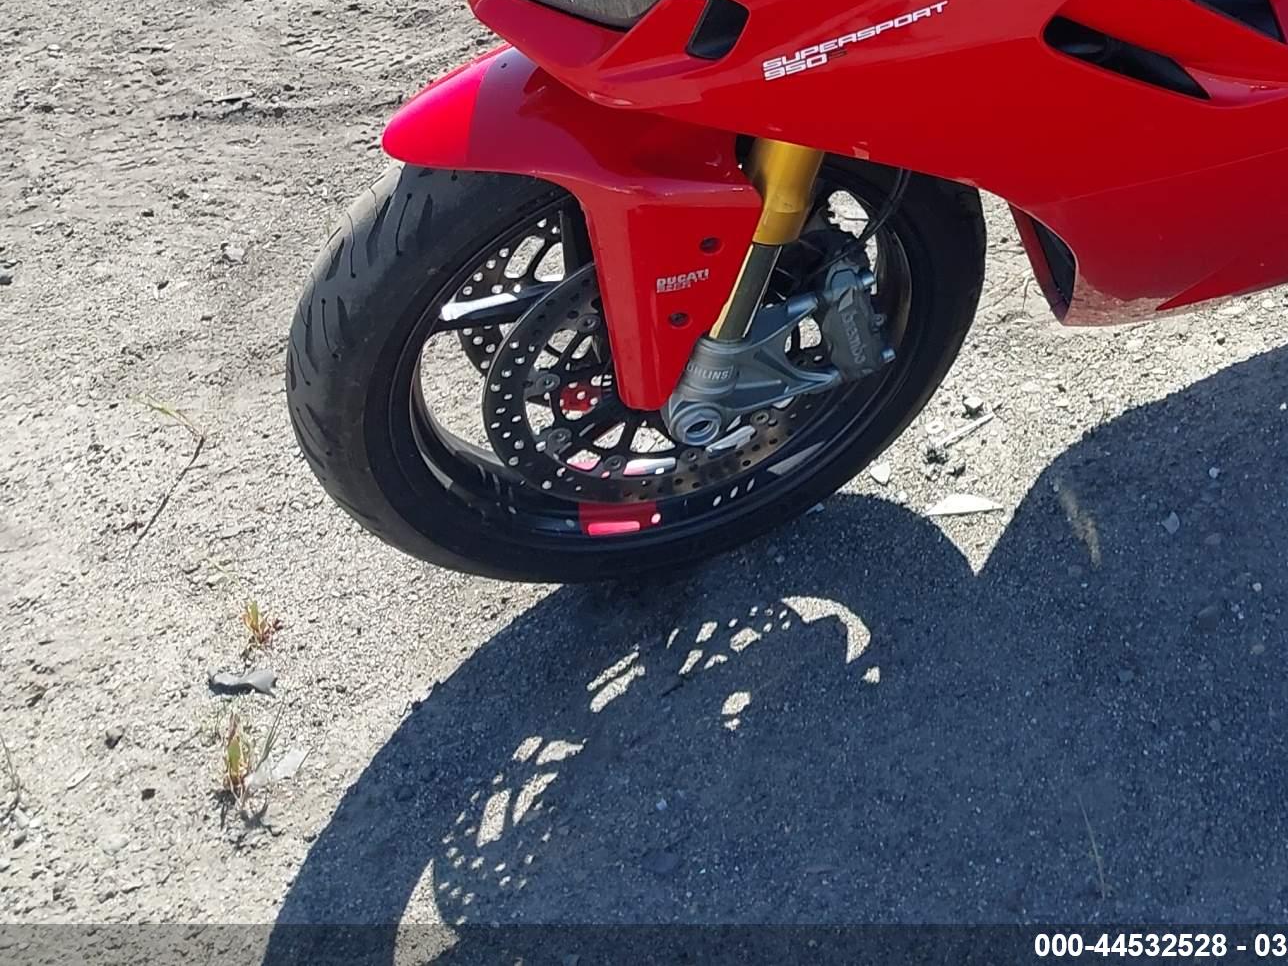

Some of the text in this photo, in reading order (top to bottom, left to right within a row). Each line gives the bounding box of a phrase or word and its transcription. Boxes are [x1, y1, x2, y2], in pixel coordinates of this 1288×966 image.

[762, 0, 949, 72] SUPERSPORT
[764, 52, 828, 82] 950
[656, 268, 709, 286] DUCATI
